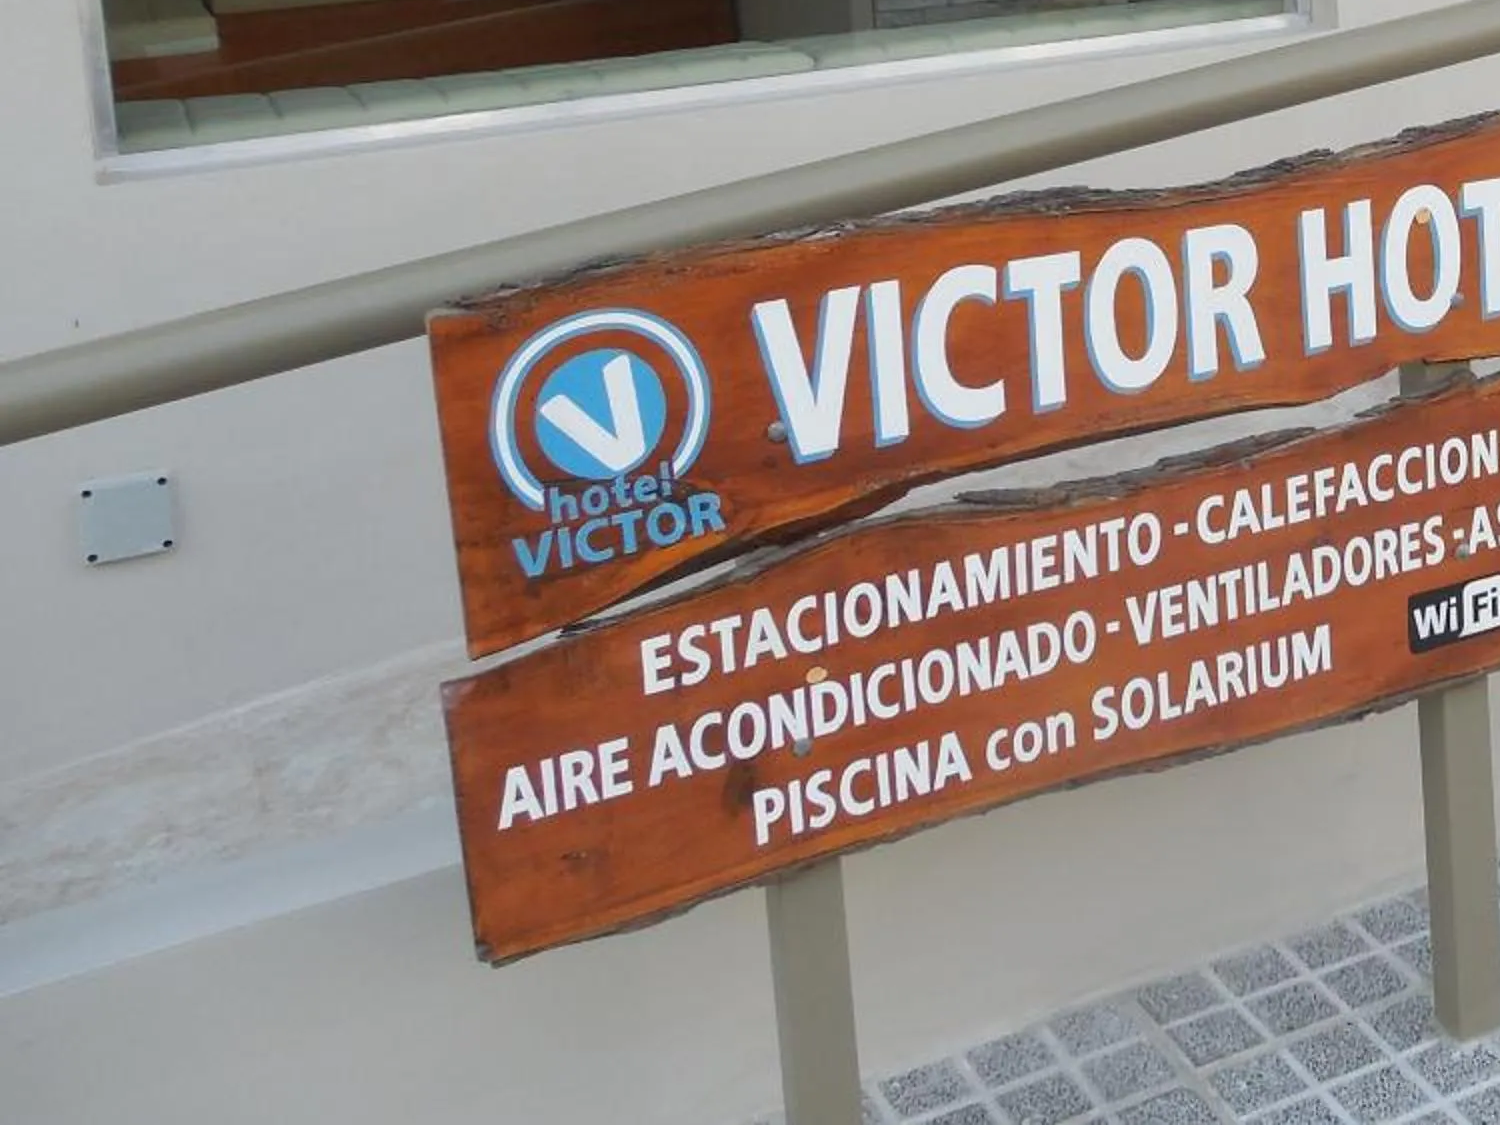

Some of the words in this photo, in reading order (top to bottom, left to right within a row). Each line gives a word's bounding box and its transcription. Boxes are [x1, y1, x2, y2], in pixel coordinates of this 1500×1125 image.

[539, 353, 646, 472] V
[751, 223, 1267, 465] VICTOR
[511, 491, 726, 578] VICTOR
[549, 460, 673, 524] hotel
[639, 512, 1162, 695] ESTACIONAMIENTO
[497, 736, 634, 832] AIRE
[648, 610, 1097, 787] ACONDICIONADO
[752, 731, 973, 846] PISCINA
[985, 710, 1076, 771] con
[1091, 624, 1333, 741] SOLARIUM
